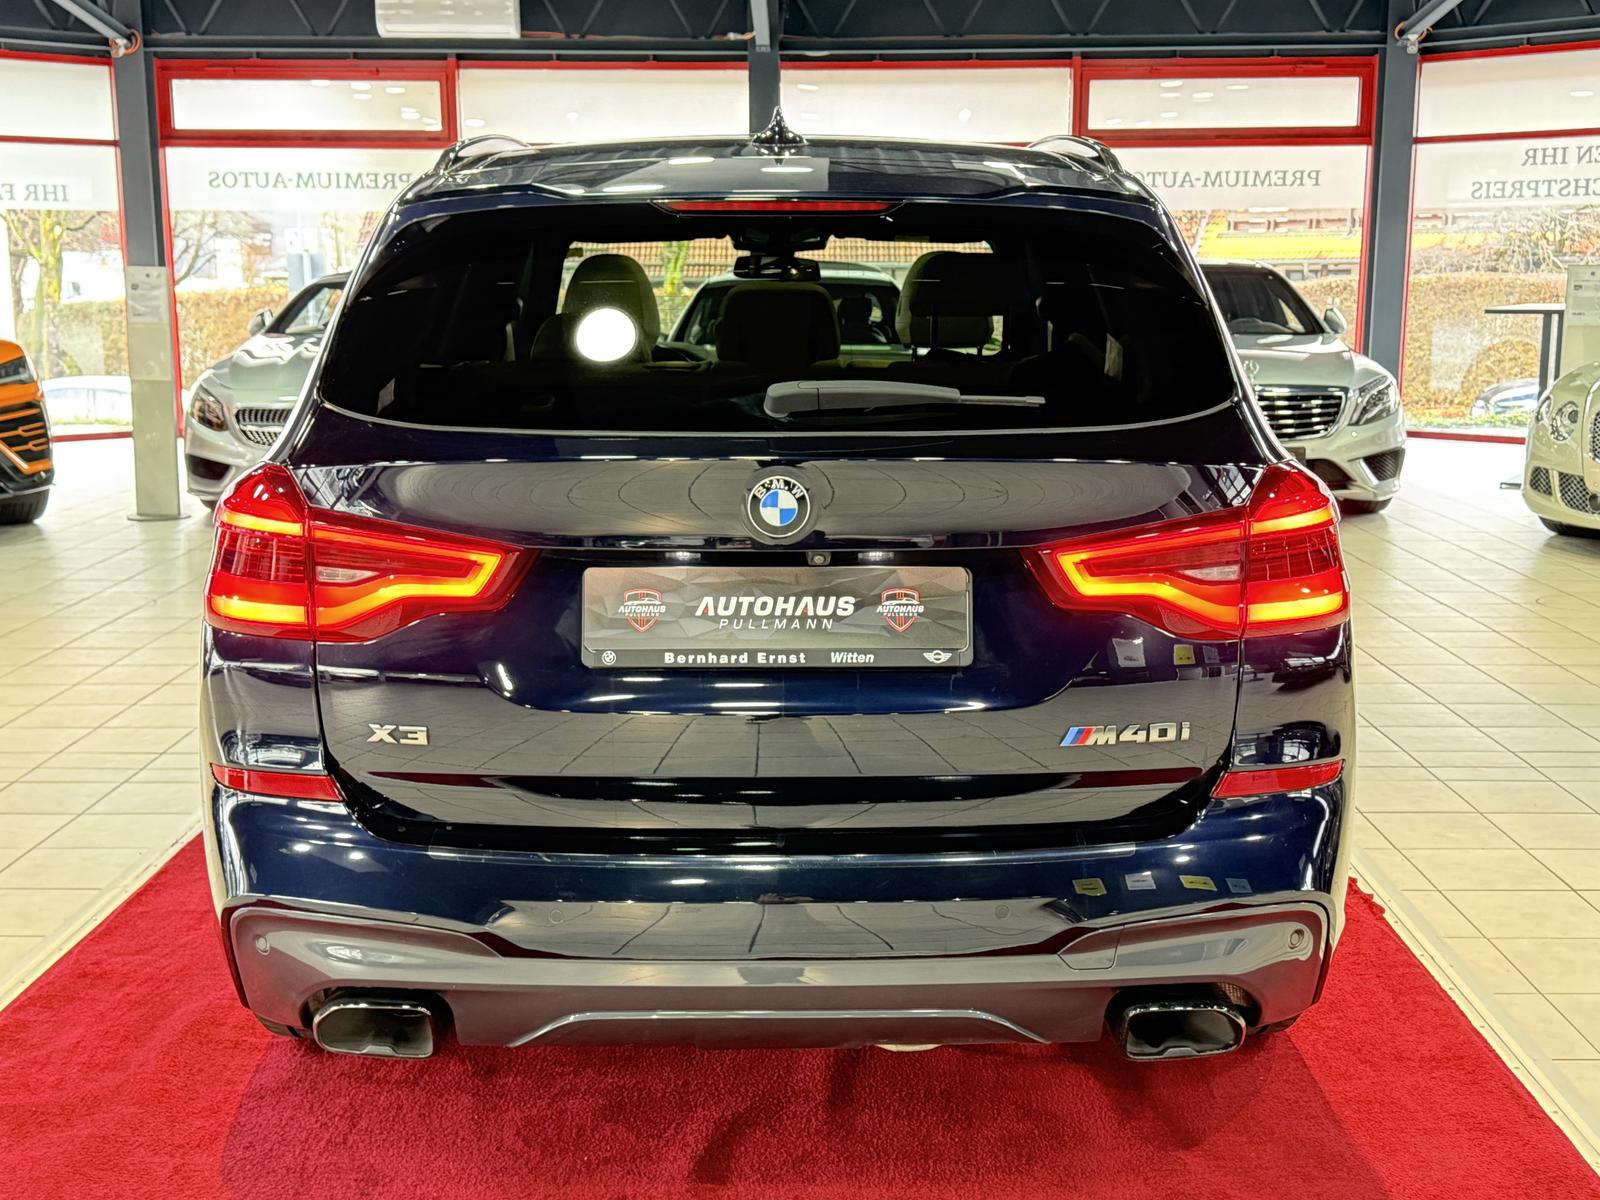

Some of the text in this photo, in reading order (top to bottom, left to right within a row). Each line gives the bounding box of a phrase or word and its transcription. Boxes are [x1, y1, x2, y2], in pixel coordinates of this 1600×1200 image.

[695, 596, 856, 617] AUTOHAUS
[719, 619, 833, 630] PULLMANN
[664, 651, 875, 664] Bernhard Ernst Witten
[366, 723, 429, 746] X3
[1085, 721, 1190, 745] M40i
